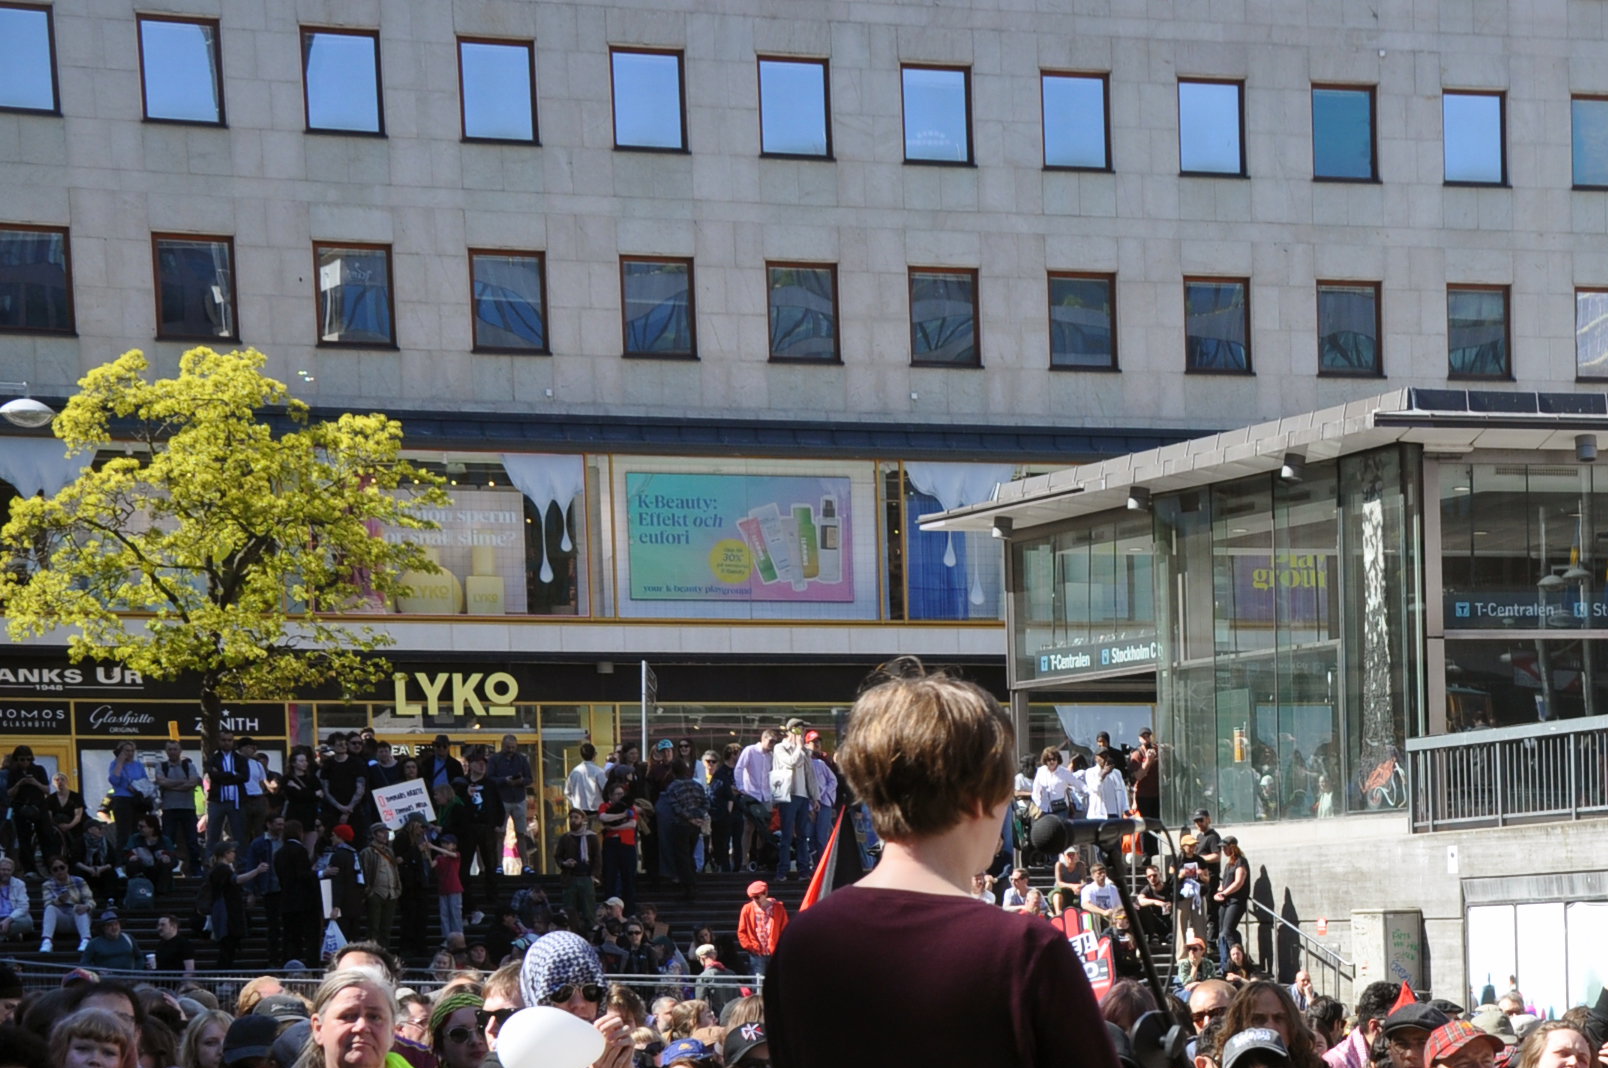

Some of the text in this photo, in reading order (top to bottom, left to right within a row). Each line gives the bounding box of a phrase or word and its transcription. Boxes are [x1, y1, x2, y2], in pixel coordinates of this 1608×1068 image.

[638, 494, 717, 511] K-Beauty:
[457, 508, 517, 527] sperm
[638, 512, 723, 528] Effekt och
[457, 529, 517, 546] slime?
[639, 528, 690, 545] eufori
[1475, 601, 1555, 617] T-Centralen
[1050, 652, 1091, 671] T-Centralen
[1111, 643, 1150, 663] Stockholm
[394, 672, 519, 716] LYKO
[109, 725, 140, 733] ORIGINAL
[194, 716, 259, 732] ZNITH
